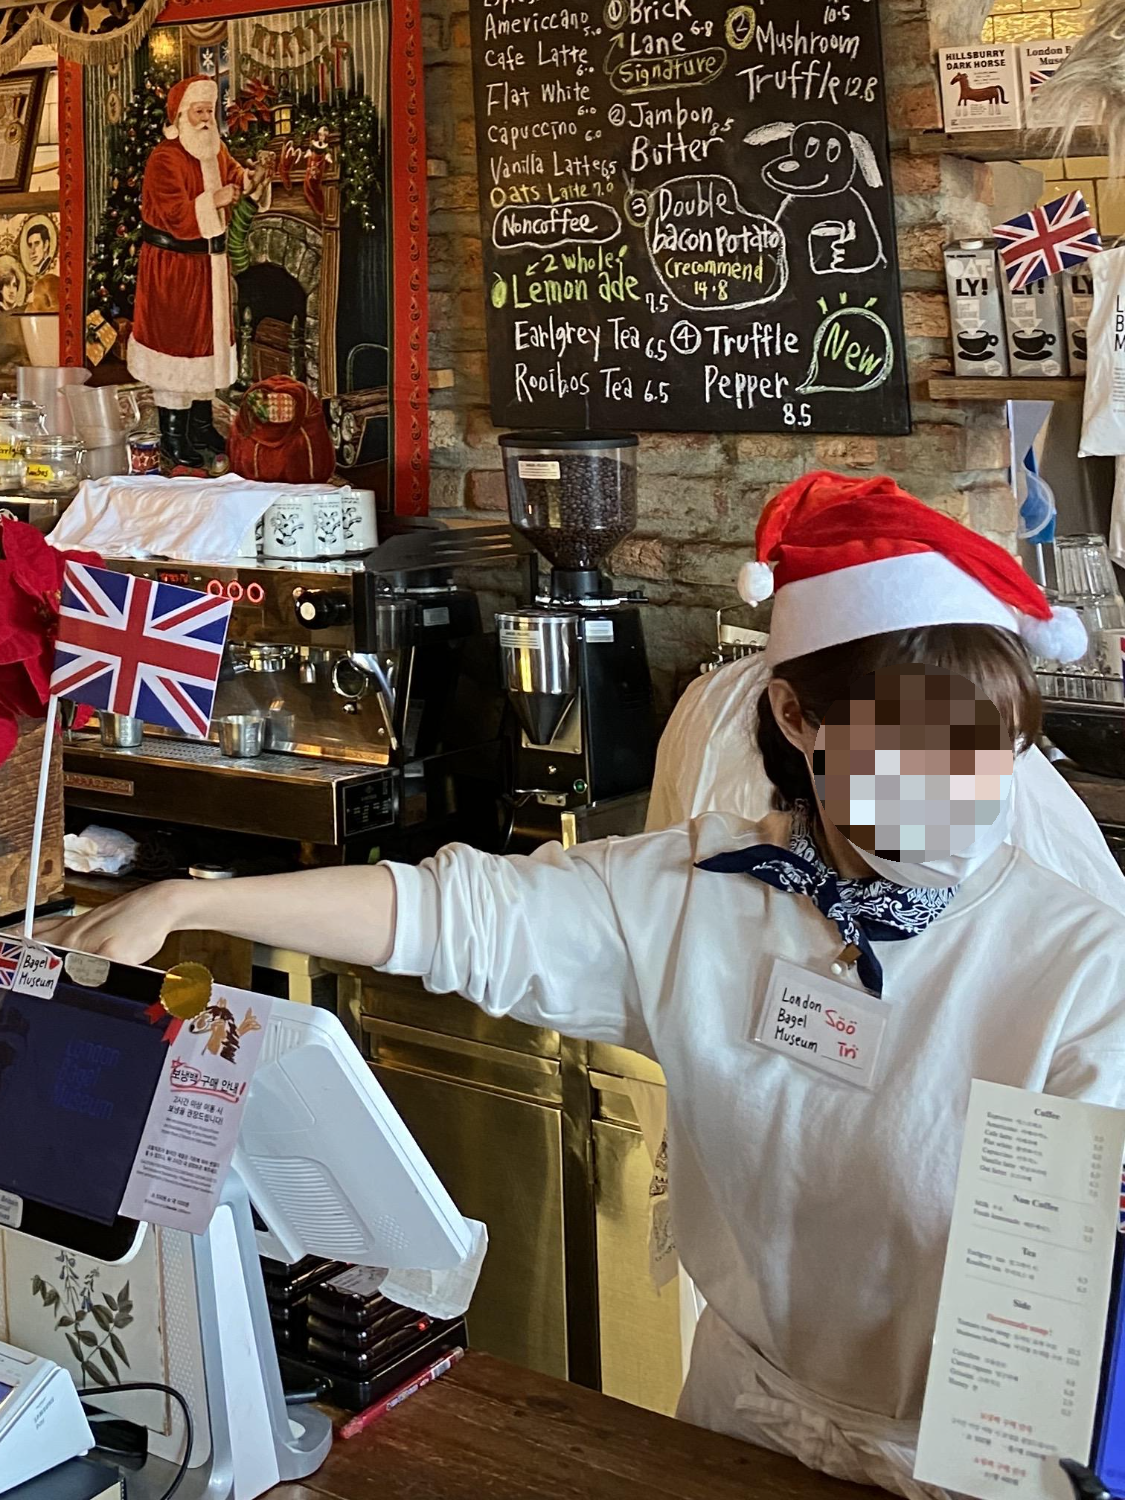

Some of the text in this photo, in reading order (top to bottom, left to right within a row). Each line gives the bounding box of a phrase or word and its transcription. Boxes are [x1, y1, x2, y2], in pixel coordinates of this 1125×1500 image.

[824, 5, 851, 24] 10.5
[538, 41, 588, 67] Latte
[630, 31, 686, 57] Lane
[756, 19, 860, 61] Mushroom
[1026, 46, 1063, 57] London
[945, 49, 1006, 61] HILLSBURRY
[946, 59, 1007, 71] DARK HORSE
[736, 60, 840, 105] Truffle
[486, 80, 530, 116] Flat
[541, 80, 590, 104] White
[628, 97, 713, 130] Jambon
[631, 132, 724, 171] Butter
[490, 151, 544, 185] Vanilla
[553, 151, 601, 178] Latte
[490, 184, 540, 208] Oats
[548, 183, 589, 204] Latte
[659, 181, 736, 222] Double
[502, 208, 598, 237] Noncoffee
[561, 245, 614, 274] whole
[512, 274, 588, 308] Lemon
[955, 277, 989, 298] LY!
[514, 315, 668, 362] Earlgrey Tea 6.5
[704, 321, 800, 359] Truffle
[824, 322, 882, 376] New
[515, 361, 671, 404] Rooibos Tea 6.5
[704, 365, 813, 427] Pepper 8.5
[23, 954, 48, 973] Bagel
[18, 973, 55, 990] Museum
[781, 987, 822, 1013] London
[777, 1007, 807, 1029] Bagel
[774, 1025, 818, 1053] Museum
[200, 1074, 220, 1090] 구매
